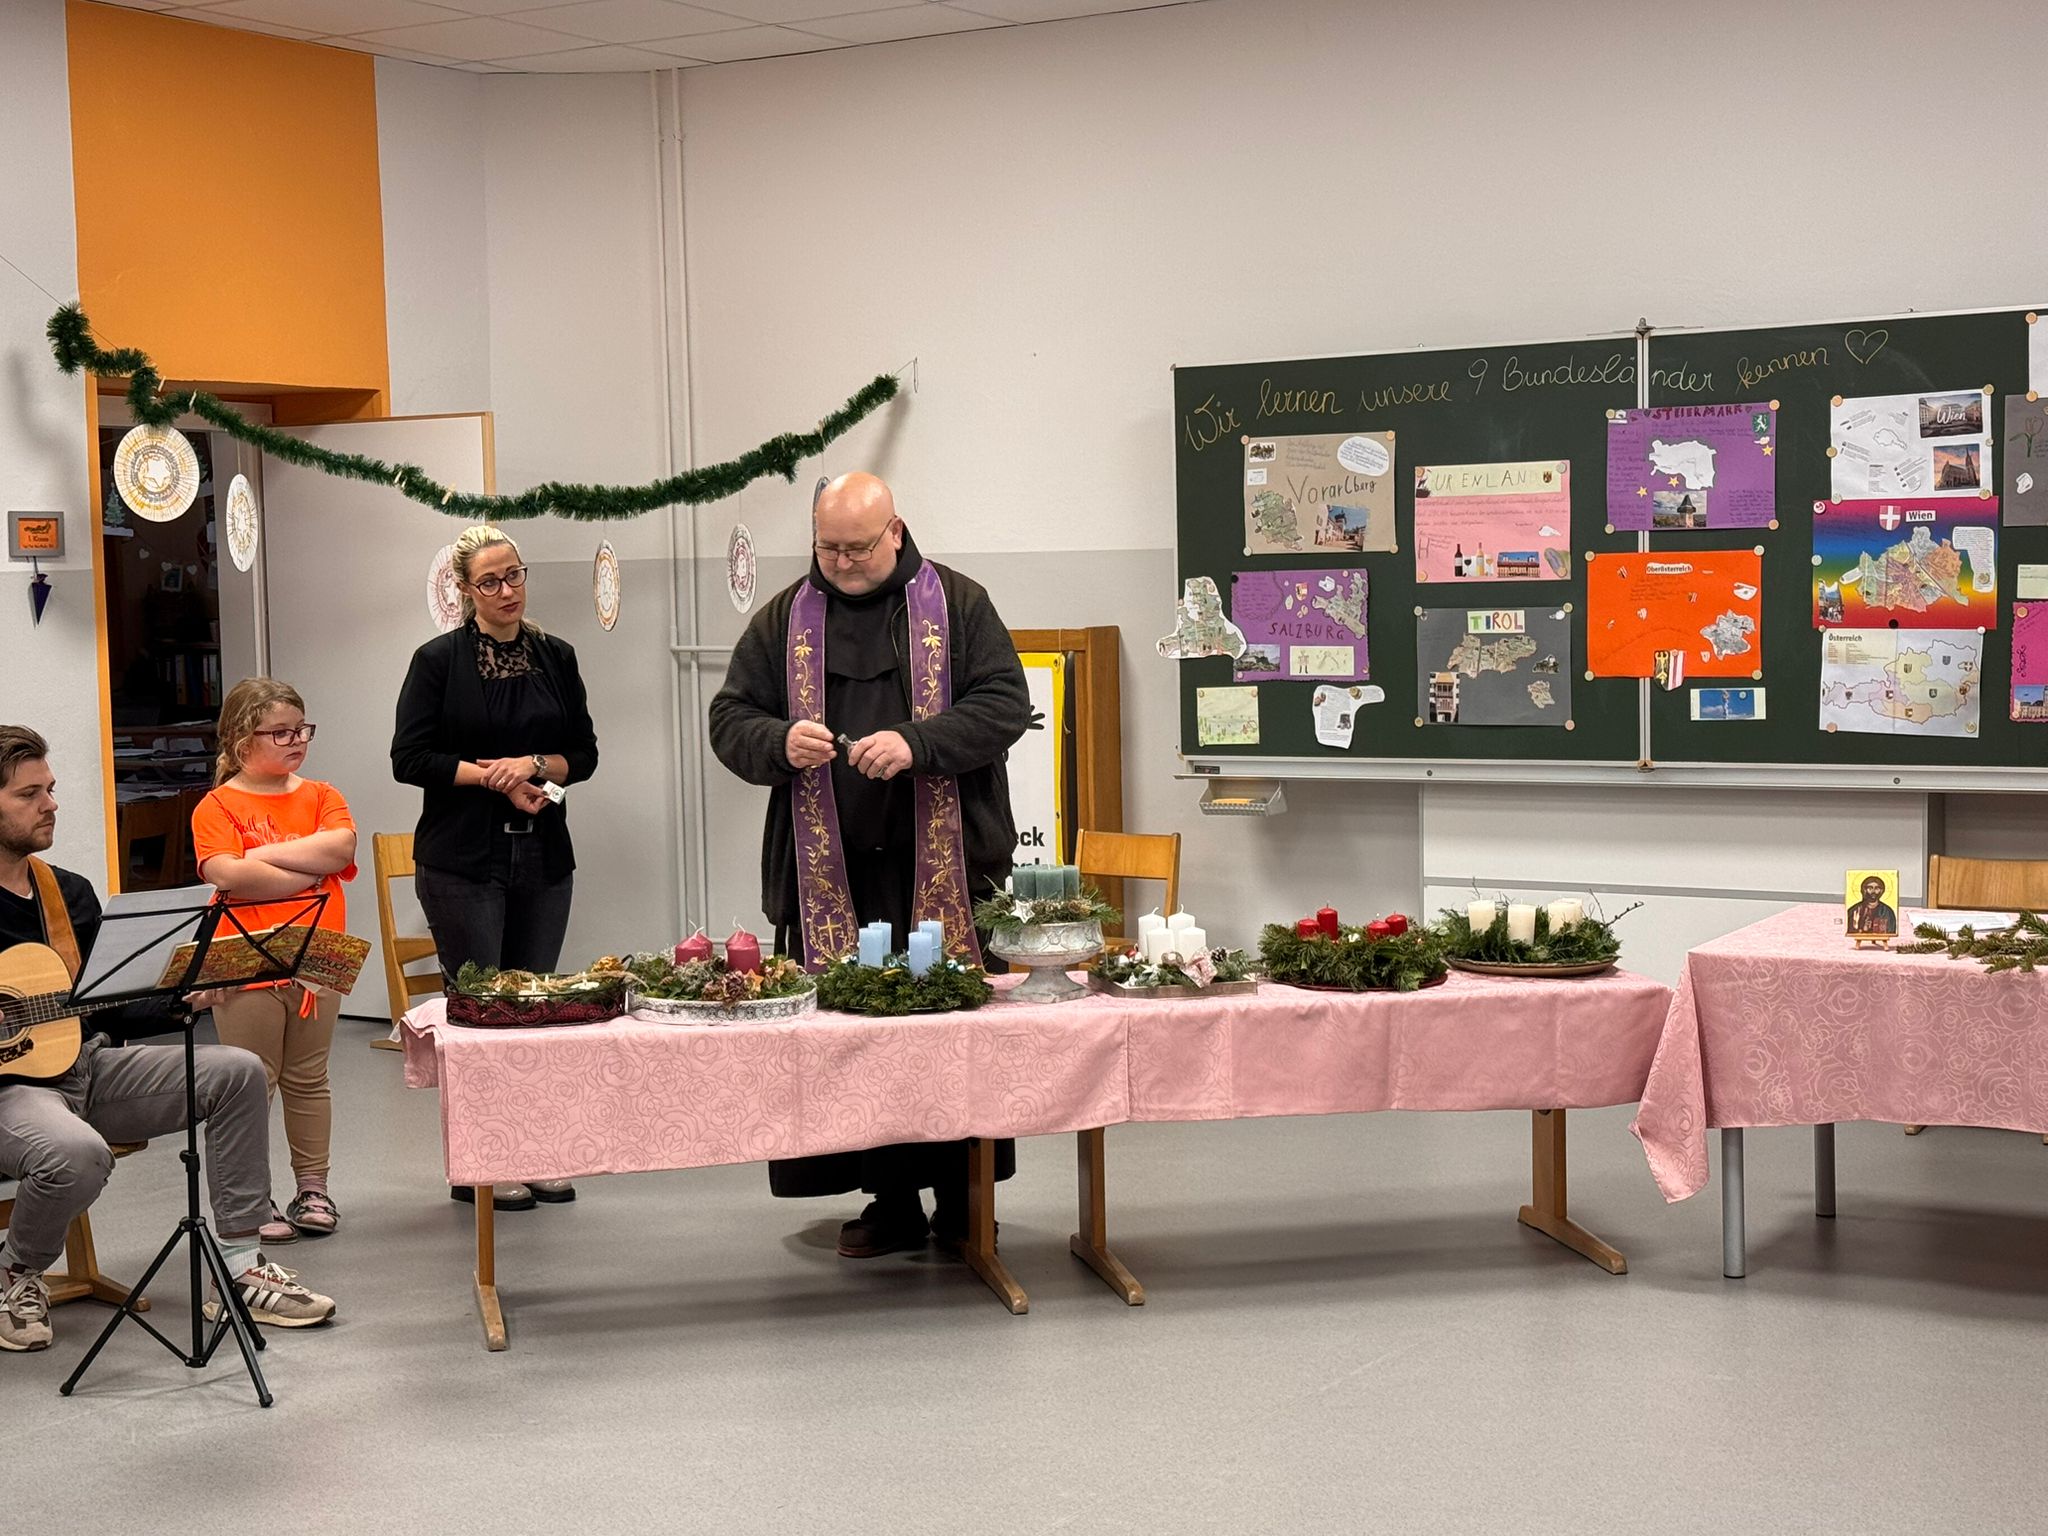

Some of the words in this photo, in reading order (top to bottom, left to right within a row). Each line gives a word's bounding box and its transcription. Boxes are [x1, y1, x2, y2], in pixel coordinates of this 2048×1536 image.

[1184, 393, 1241, 452] Wir
[1255, 378, 1344, 421] lernen
[1359, 379, 1454, 412] unsere
[1466, 358, 1490, 396] 9
[1736, 346, 1830, 395] kennen
[1652, 404, 1742, 420] STEIERMARK
[1937, 405, 1968, 425] Wien
[1286, 475, 1377, 504] Vorarlberg
[1908, 511, 1934, 521] Wien
[1470, 611, 1524, 630] TIROL
[1268, 622, 1345, 641] SALZBURG
[1828, 633, 1863, 642] Österreich
